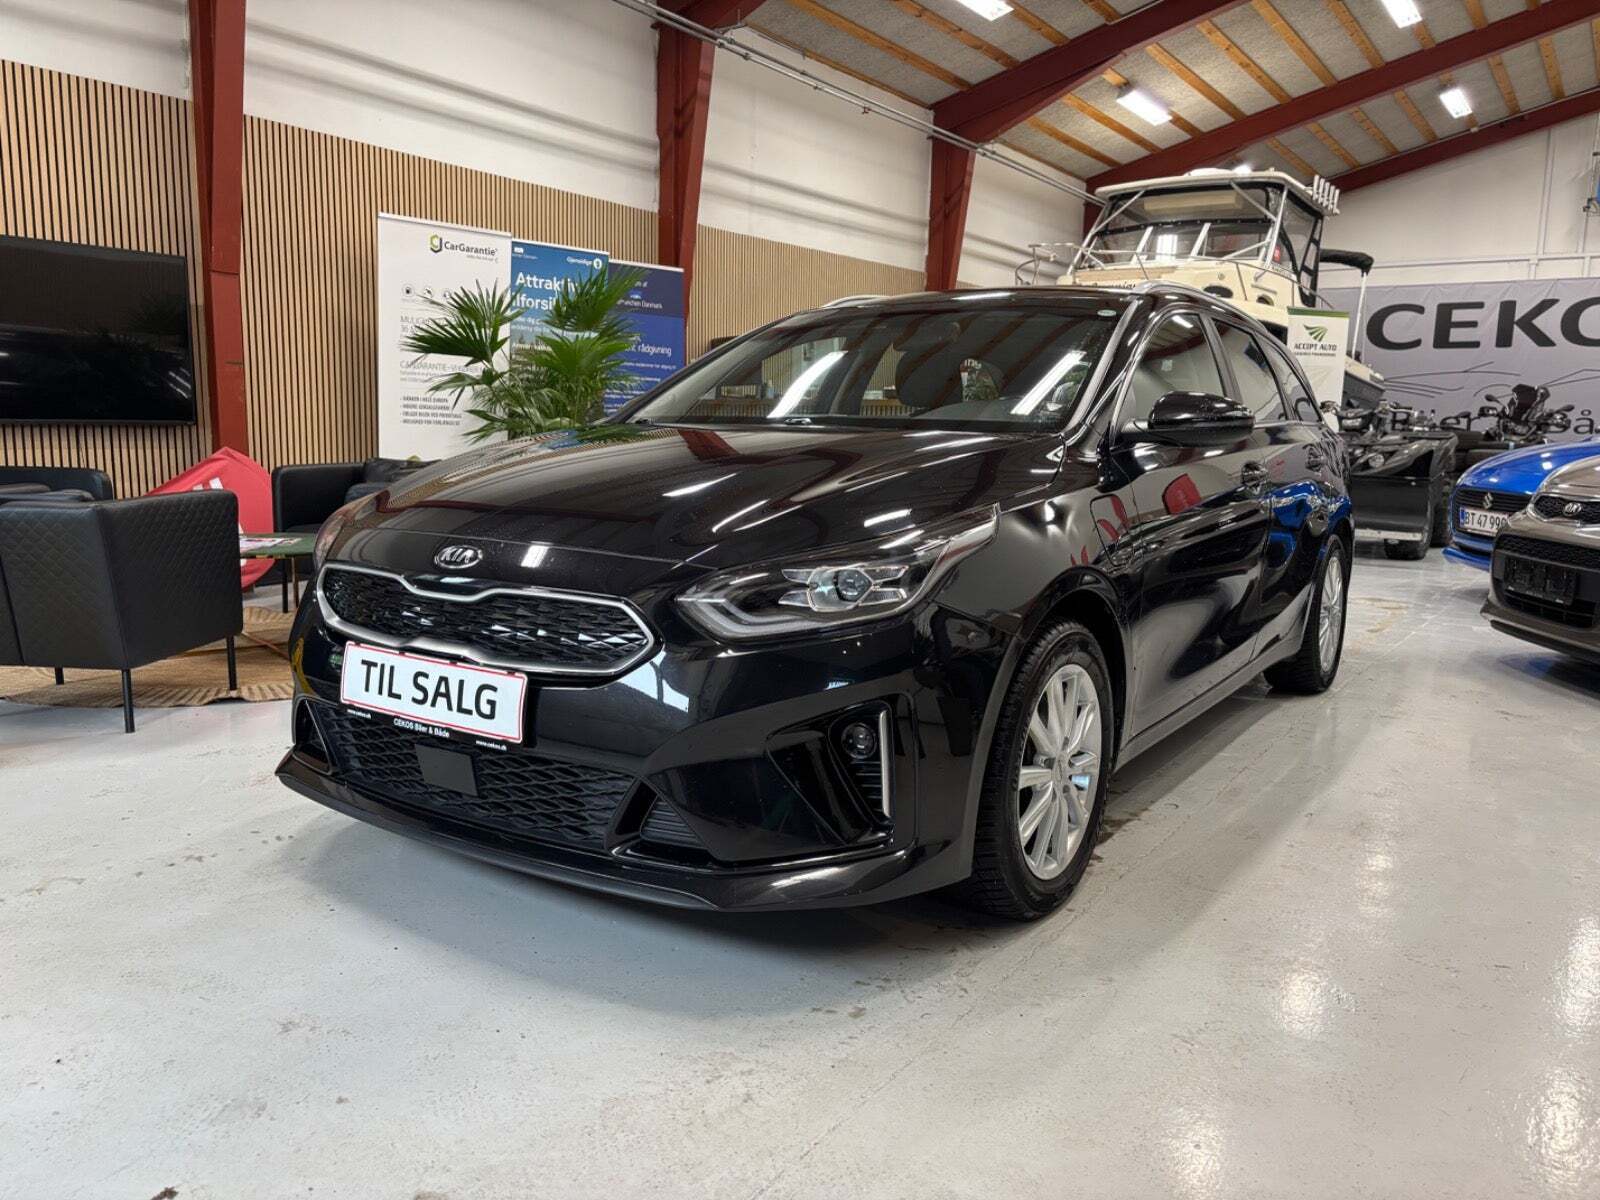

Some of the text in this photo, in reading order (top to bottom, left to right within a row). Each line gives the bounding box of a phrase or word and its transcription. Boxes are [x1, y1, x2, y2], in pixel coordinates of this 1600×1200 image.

[443, 240, 496, 256] CarGarantie
[1465, 511, 1476, 526] BT
[1478, 514, 1488, 528] 47
[441, 548, 475, 564] KIA
[361, 659, 498, 720] TIL SALG
[393, 717, 414, 730] CEKOS
